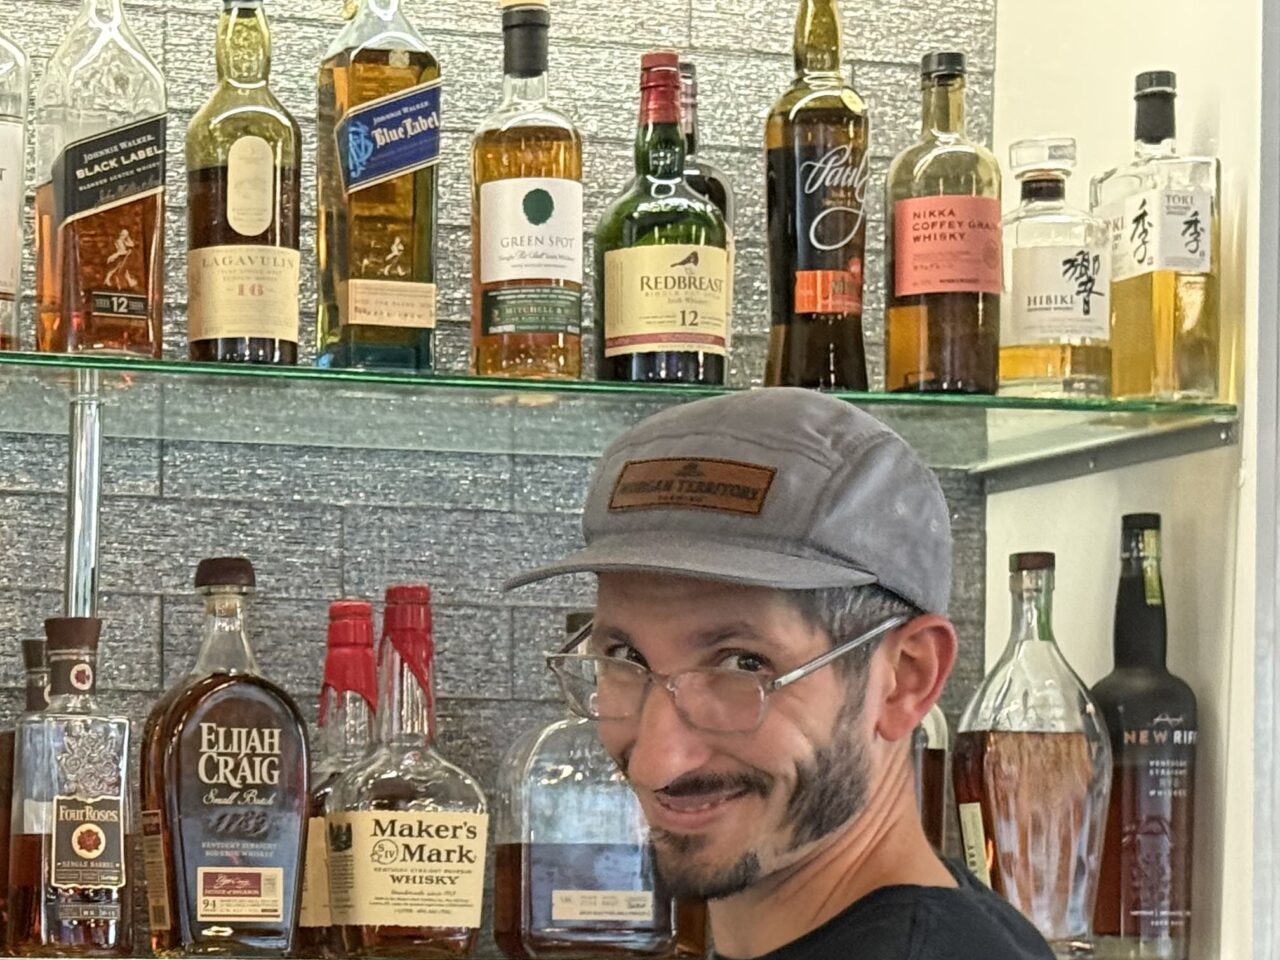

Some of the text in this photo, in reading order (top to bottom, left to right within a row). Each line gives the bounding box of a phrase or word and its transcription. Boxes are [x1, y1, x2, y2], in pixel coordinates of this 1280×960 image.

[371, 110, 440, 150] Blue Label
[83, 134, 156, 164] JOHNNIE WALKER
[75, 145, 164, 180] BLACK LABEL
[1166, 194, 1194, 206] TOKI
[912, 208, 956, 220] NIKKA
[912, 220, 964, 231] COFFEY
[500, 235, 575, 248] GREEN SPOT
[912, 232, 966, 242] WHISKY
[202, 255, 295, 268] LAGAVULIN
[237, 284, 264, 296] 16
[640, 276, 724, 292] REDBREAST
[1062, 250, 1105, 316] 響
[111, 296, 129, 313] 12
[1026, 294, 1074, 306] HIBIKI
[680, 310, 699, 326] 12
[199, 722, 281, 754] ELIJAH
[1124, 730, 1168, 746] NEW
[198, 754, 280, 788] CRAIG
[202, 788, 277, 806] Small Batch
[60, 806, 118, 822] Four Roses
[371, 818, 478, 840] Maker's
[400, 844, 476, 864] Mark
[390, 874, 460, 886] WHISKY
